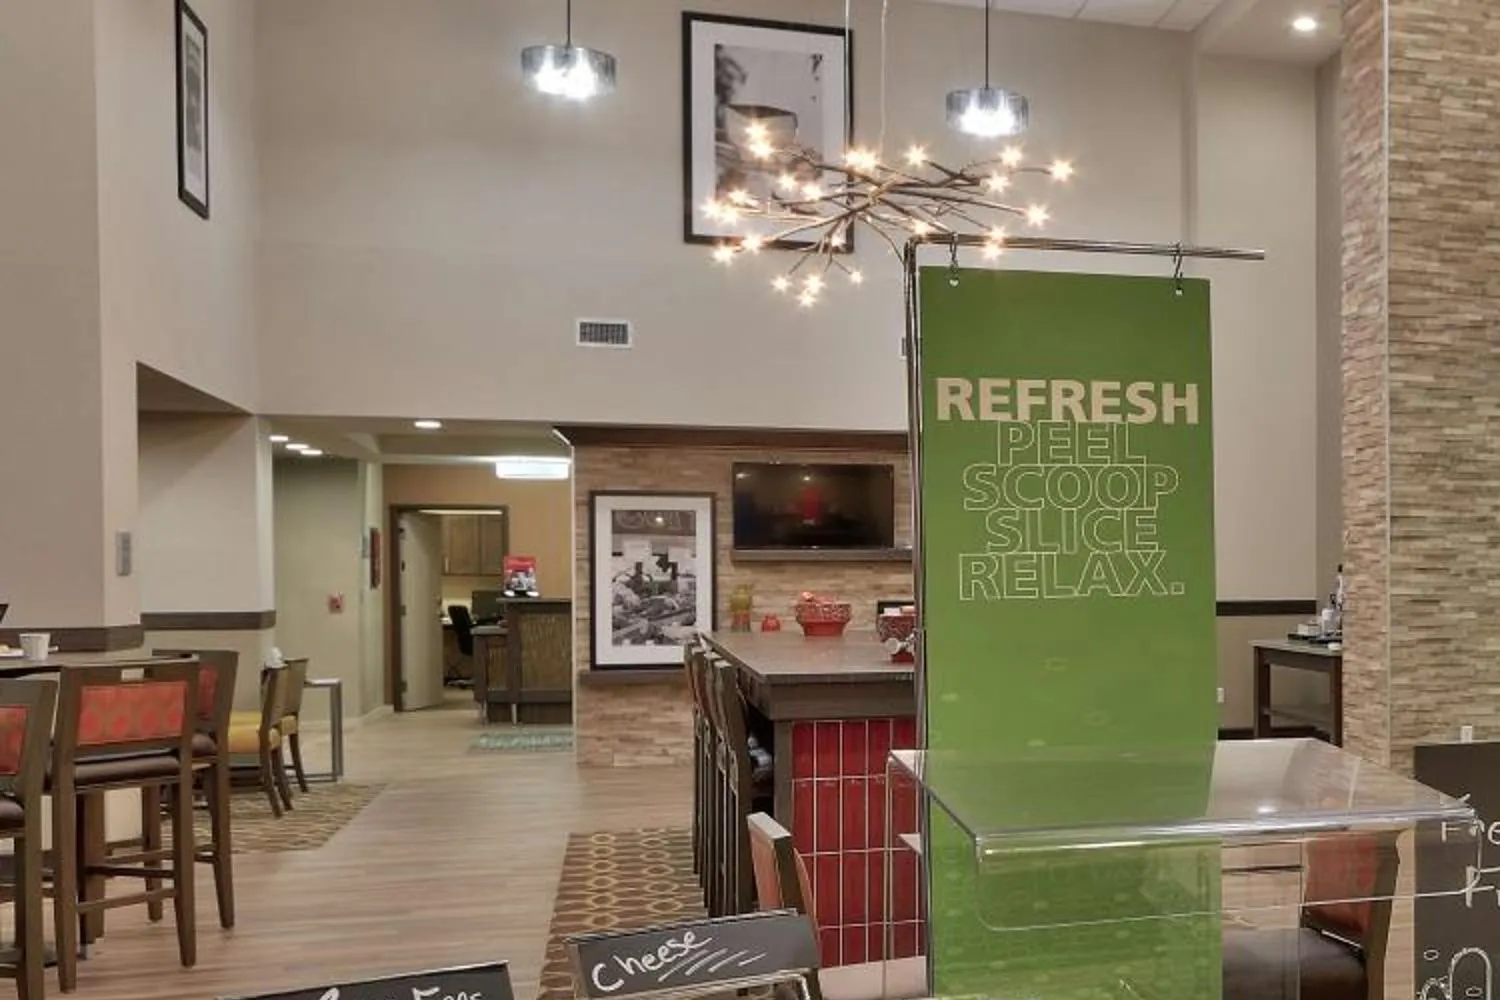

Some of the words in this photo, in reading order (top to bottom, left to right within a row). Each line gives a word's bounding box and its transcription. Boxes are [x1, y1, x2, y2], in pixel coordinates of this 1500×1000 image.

[936, 377, 1199, 424] REFRESH
[997, 420, 1148, 466] PEEL
[962, 463, 1180, 511] SCOOP
[984, 508, 1159, 555] SLICE
[958, 550, 1186, 601] RELAX.
[591, 931, 713, 993] Cheese
